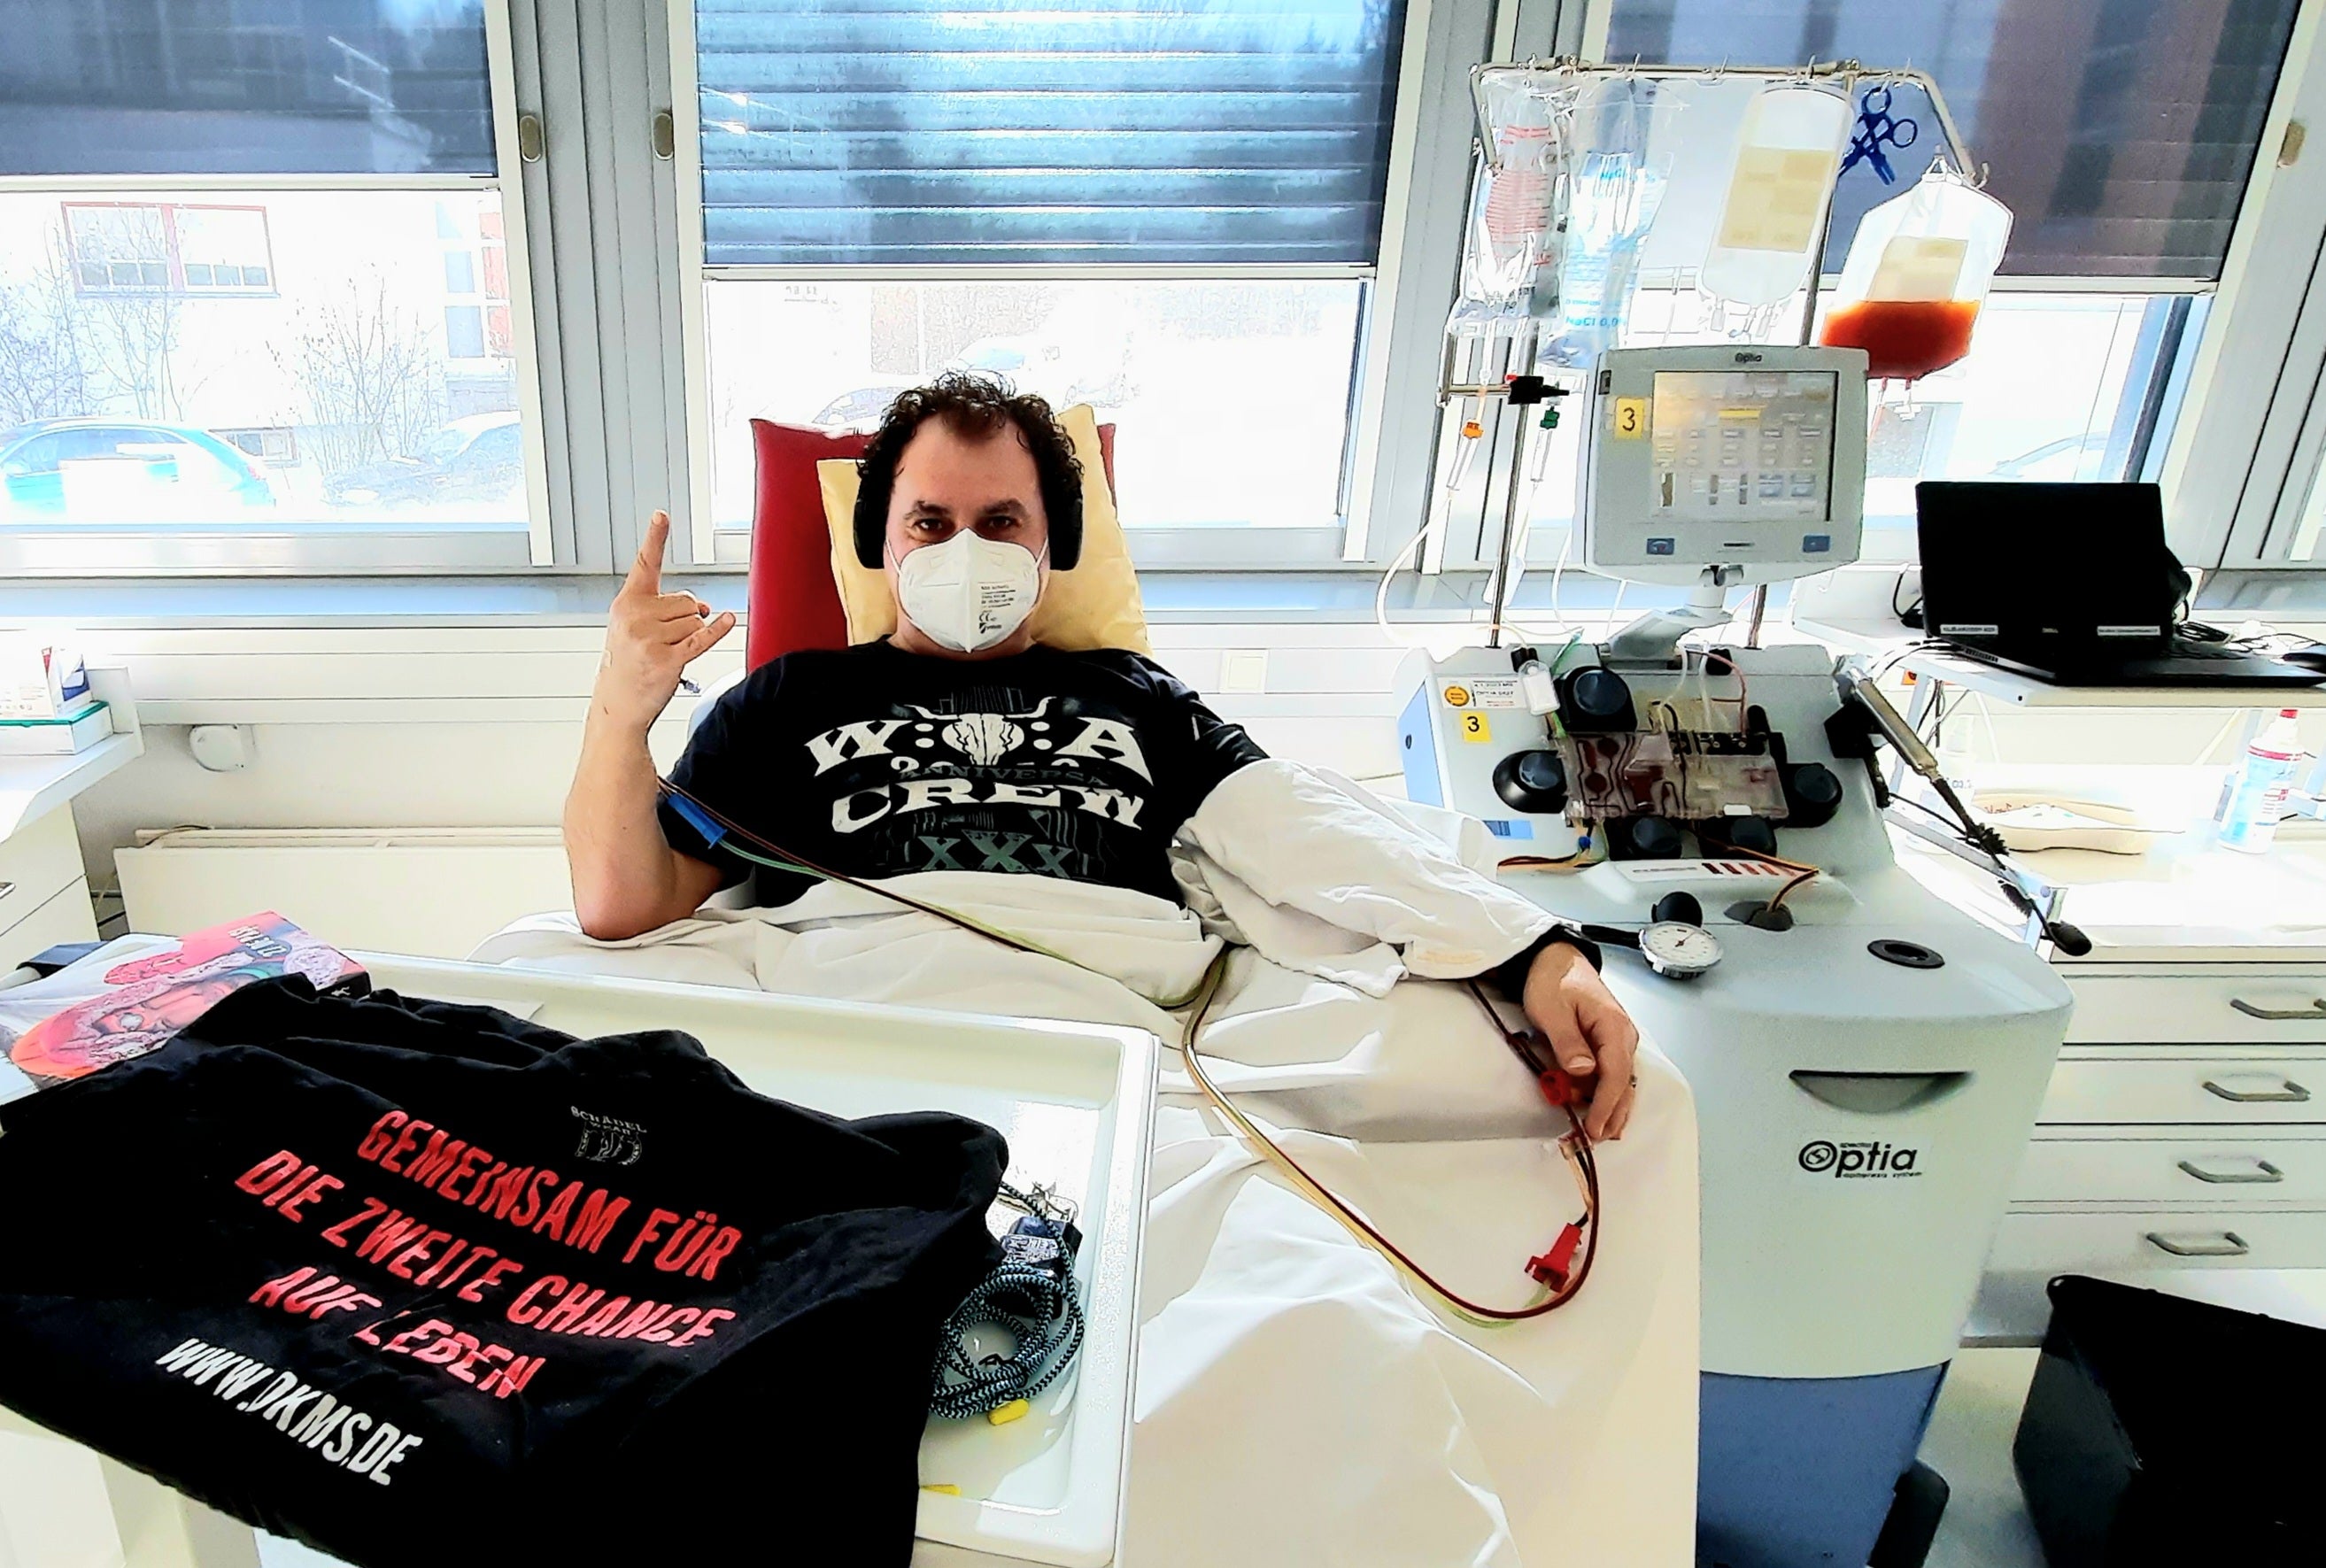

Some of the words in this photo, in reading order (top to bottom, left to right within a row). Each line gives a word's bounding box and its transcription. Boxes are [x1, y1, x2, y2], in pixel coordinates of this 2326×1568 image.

[1622, 407, 1635, 431] 3
[1467, 715, 1480, 732] 3
[900, 763, 1109, 786] ANNIVERSA
[832, 778, 1144, 833] CREW
[918, 830, 1073, 877] XXX
[1798, 1140, 1918, 1178] Optia
[358, 1110, 631, 1254] GEMEINSAM
[622, 1209, 742, 1280] FÜR
[236, 1150, 344, 1222] DIE
[321, 1197, 522, 1302] ZWEITE
[506, 1277, 736, 1347] CHANCE
[249, 1267, 382, 1320] AUF
[156, 1339, 422, 1487] WWW.DKMS.DE
